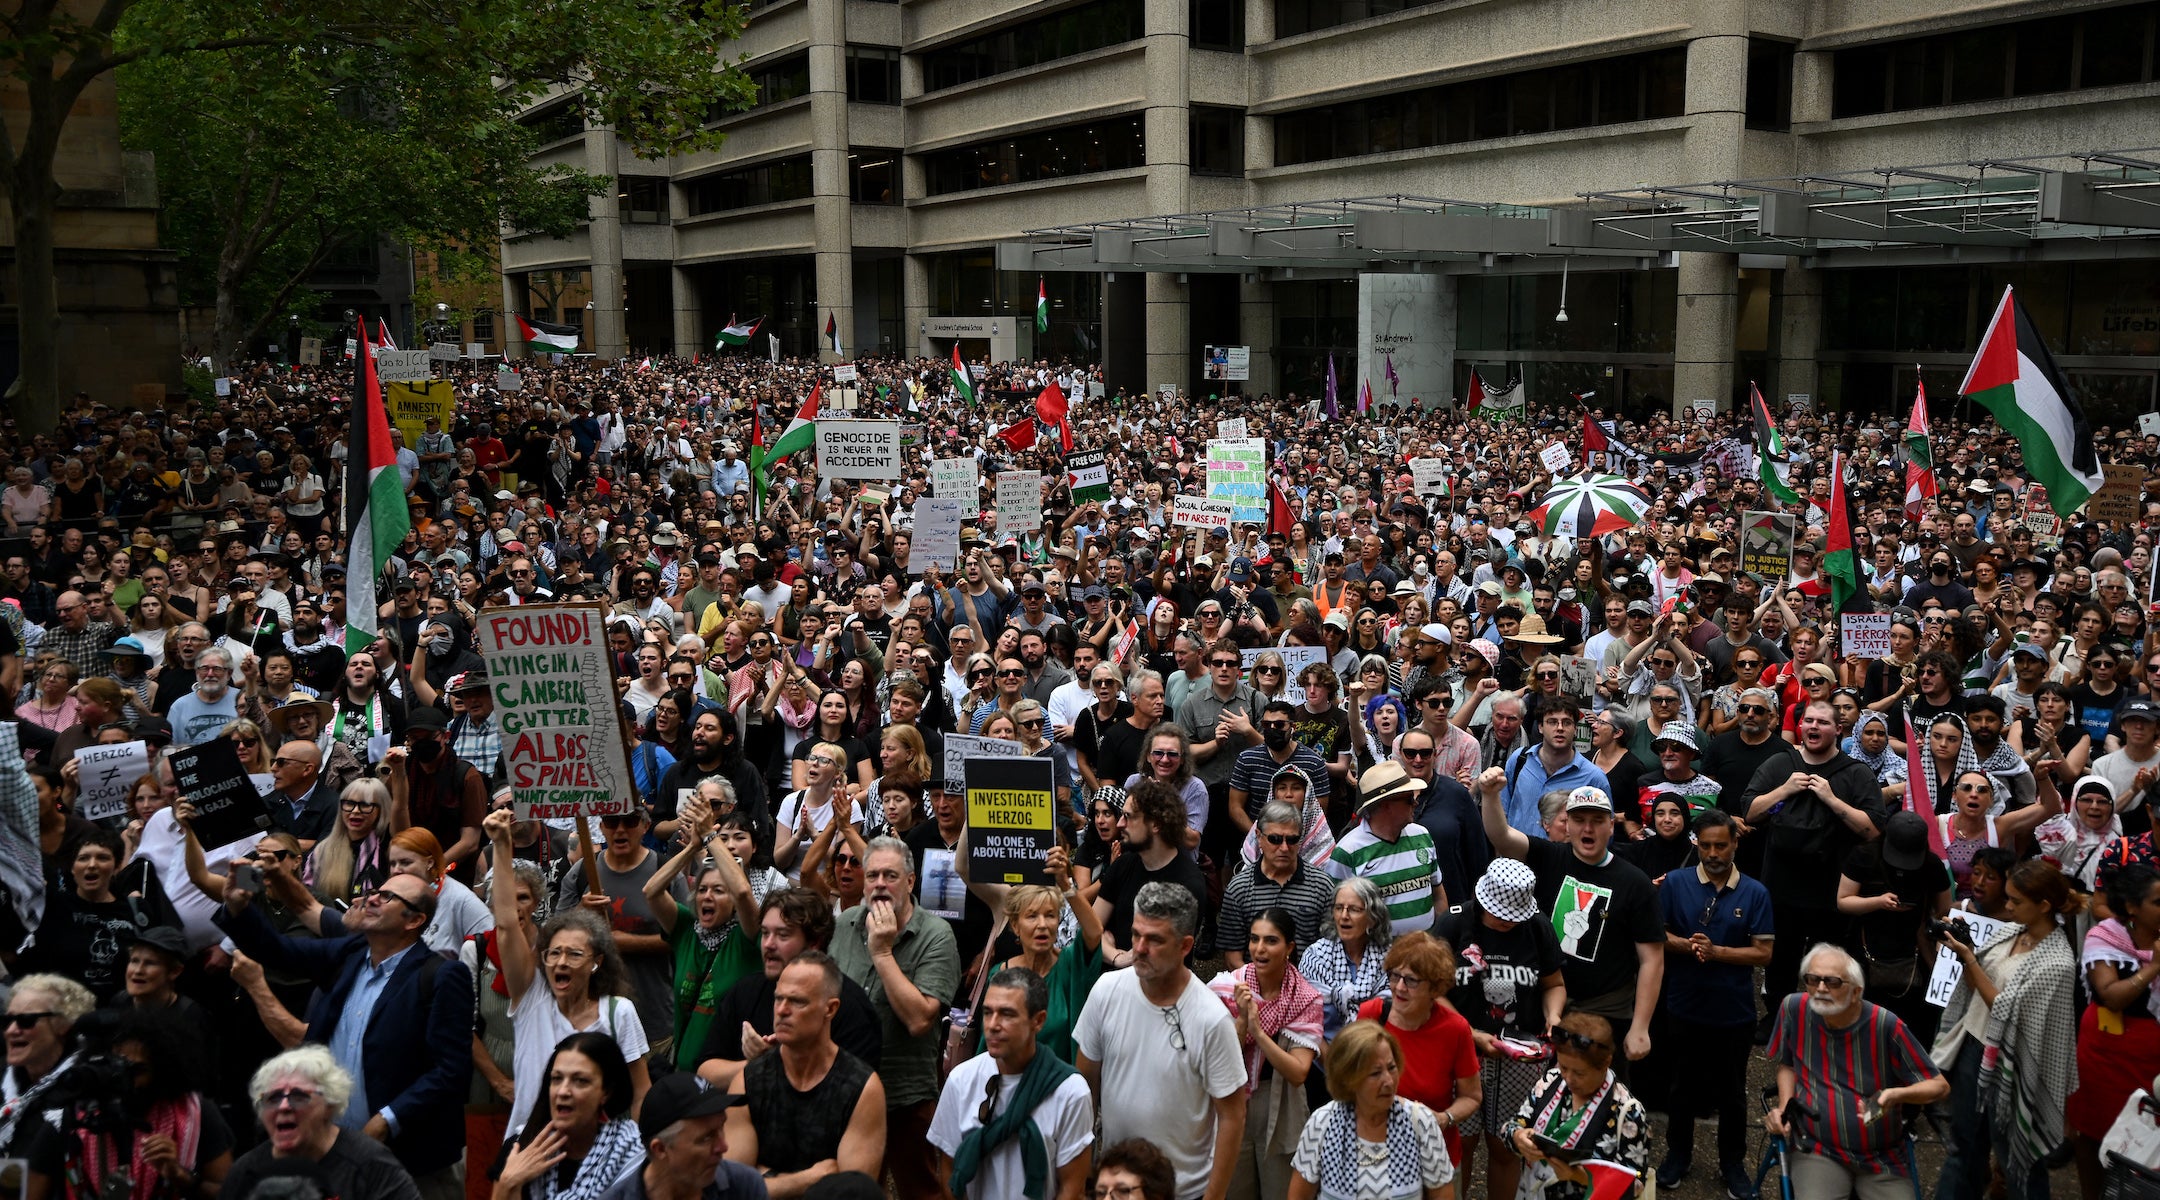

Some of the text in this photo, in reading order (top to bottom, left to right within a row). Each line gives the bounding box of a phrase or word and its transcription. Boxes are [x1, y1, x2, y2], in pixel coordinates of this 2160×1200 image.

[1375, 333, 1413, 343] St Andrew's
[1375, 346, 1396, 354] House
[379, 370, 428, 380] Genocider
[397, 401, 442, 413] AMNESTY
[824, 432, 890, 444] GENOCIDE
[828, 446, 888, 454] IS NEVER AN
[826, 456, 892, 468] ACCIDENT
[944, 461, 952, 470] No
[1070, 452, 1104, 468] FREE GAZA
[938, 470, 970, 480] hospitals
[1083, 471, 1102, 480] FREE
[938, 480, 970, 490] unlimited
[1075, 488, 1110, 500] PALESTINE
[1002, 497, 1024, 506] support
[1175, 498, 1198, 510] SOCIAL
[1200, 502, 1230, 514] COHESION
[1005, 521, 1032, 529] genocide
[1177, 512, 1226, 526] MY ARSE JIM
[2029, 524, 2054, 534] NOW
[1745, 554, 1788, 565] NO JUSTICE
[1744, 564, 1786, 576] NO PEACE
[1846, 615, 1886, 624] ISRAEL
[490, 612, 592, 650] FOUND!
[1844, 630, 1890, 640] TERROR
[1854, 641, 1888, 649] STATE
[1282, 650, 1309, 662] THE
[491, 653, 580, 676] LYING IN A
[502, 708, 590, 734] GUTTER
[510, 732, 589, 763] ALBO'S
[947, 738, 974, 748] THERE
[83, 746, 134, 764] HERZOG
[174, 755, 199, 772] STOP
[180, 774, 200, 788] THE
[514, 762, 599, 788] SPINE!
[185, 775, 244, 804] HOLOCAUST
[514, 789, 610, 804] MINT CONDITION
[974, 792, 1045, 808] INVESTIGATE
[205, 797, 235, 814] GAZA
[530, 798, 628, 818] NEVER USED!
[988, 810, 1033, 825] HERZOG
[986, 835, 1035, 848] NO ONE IS
[973, 848, 1049, 860] ABOVE THE LAW
